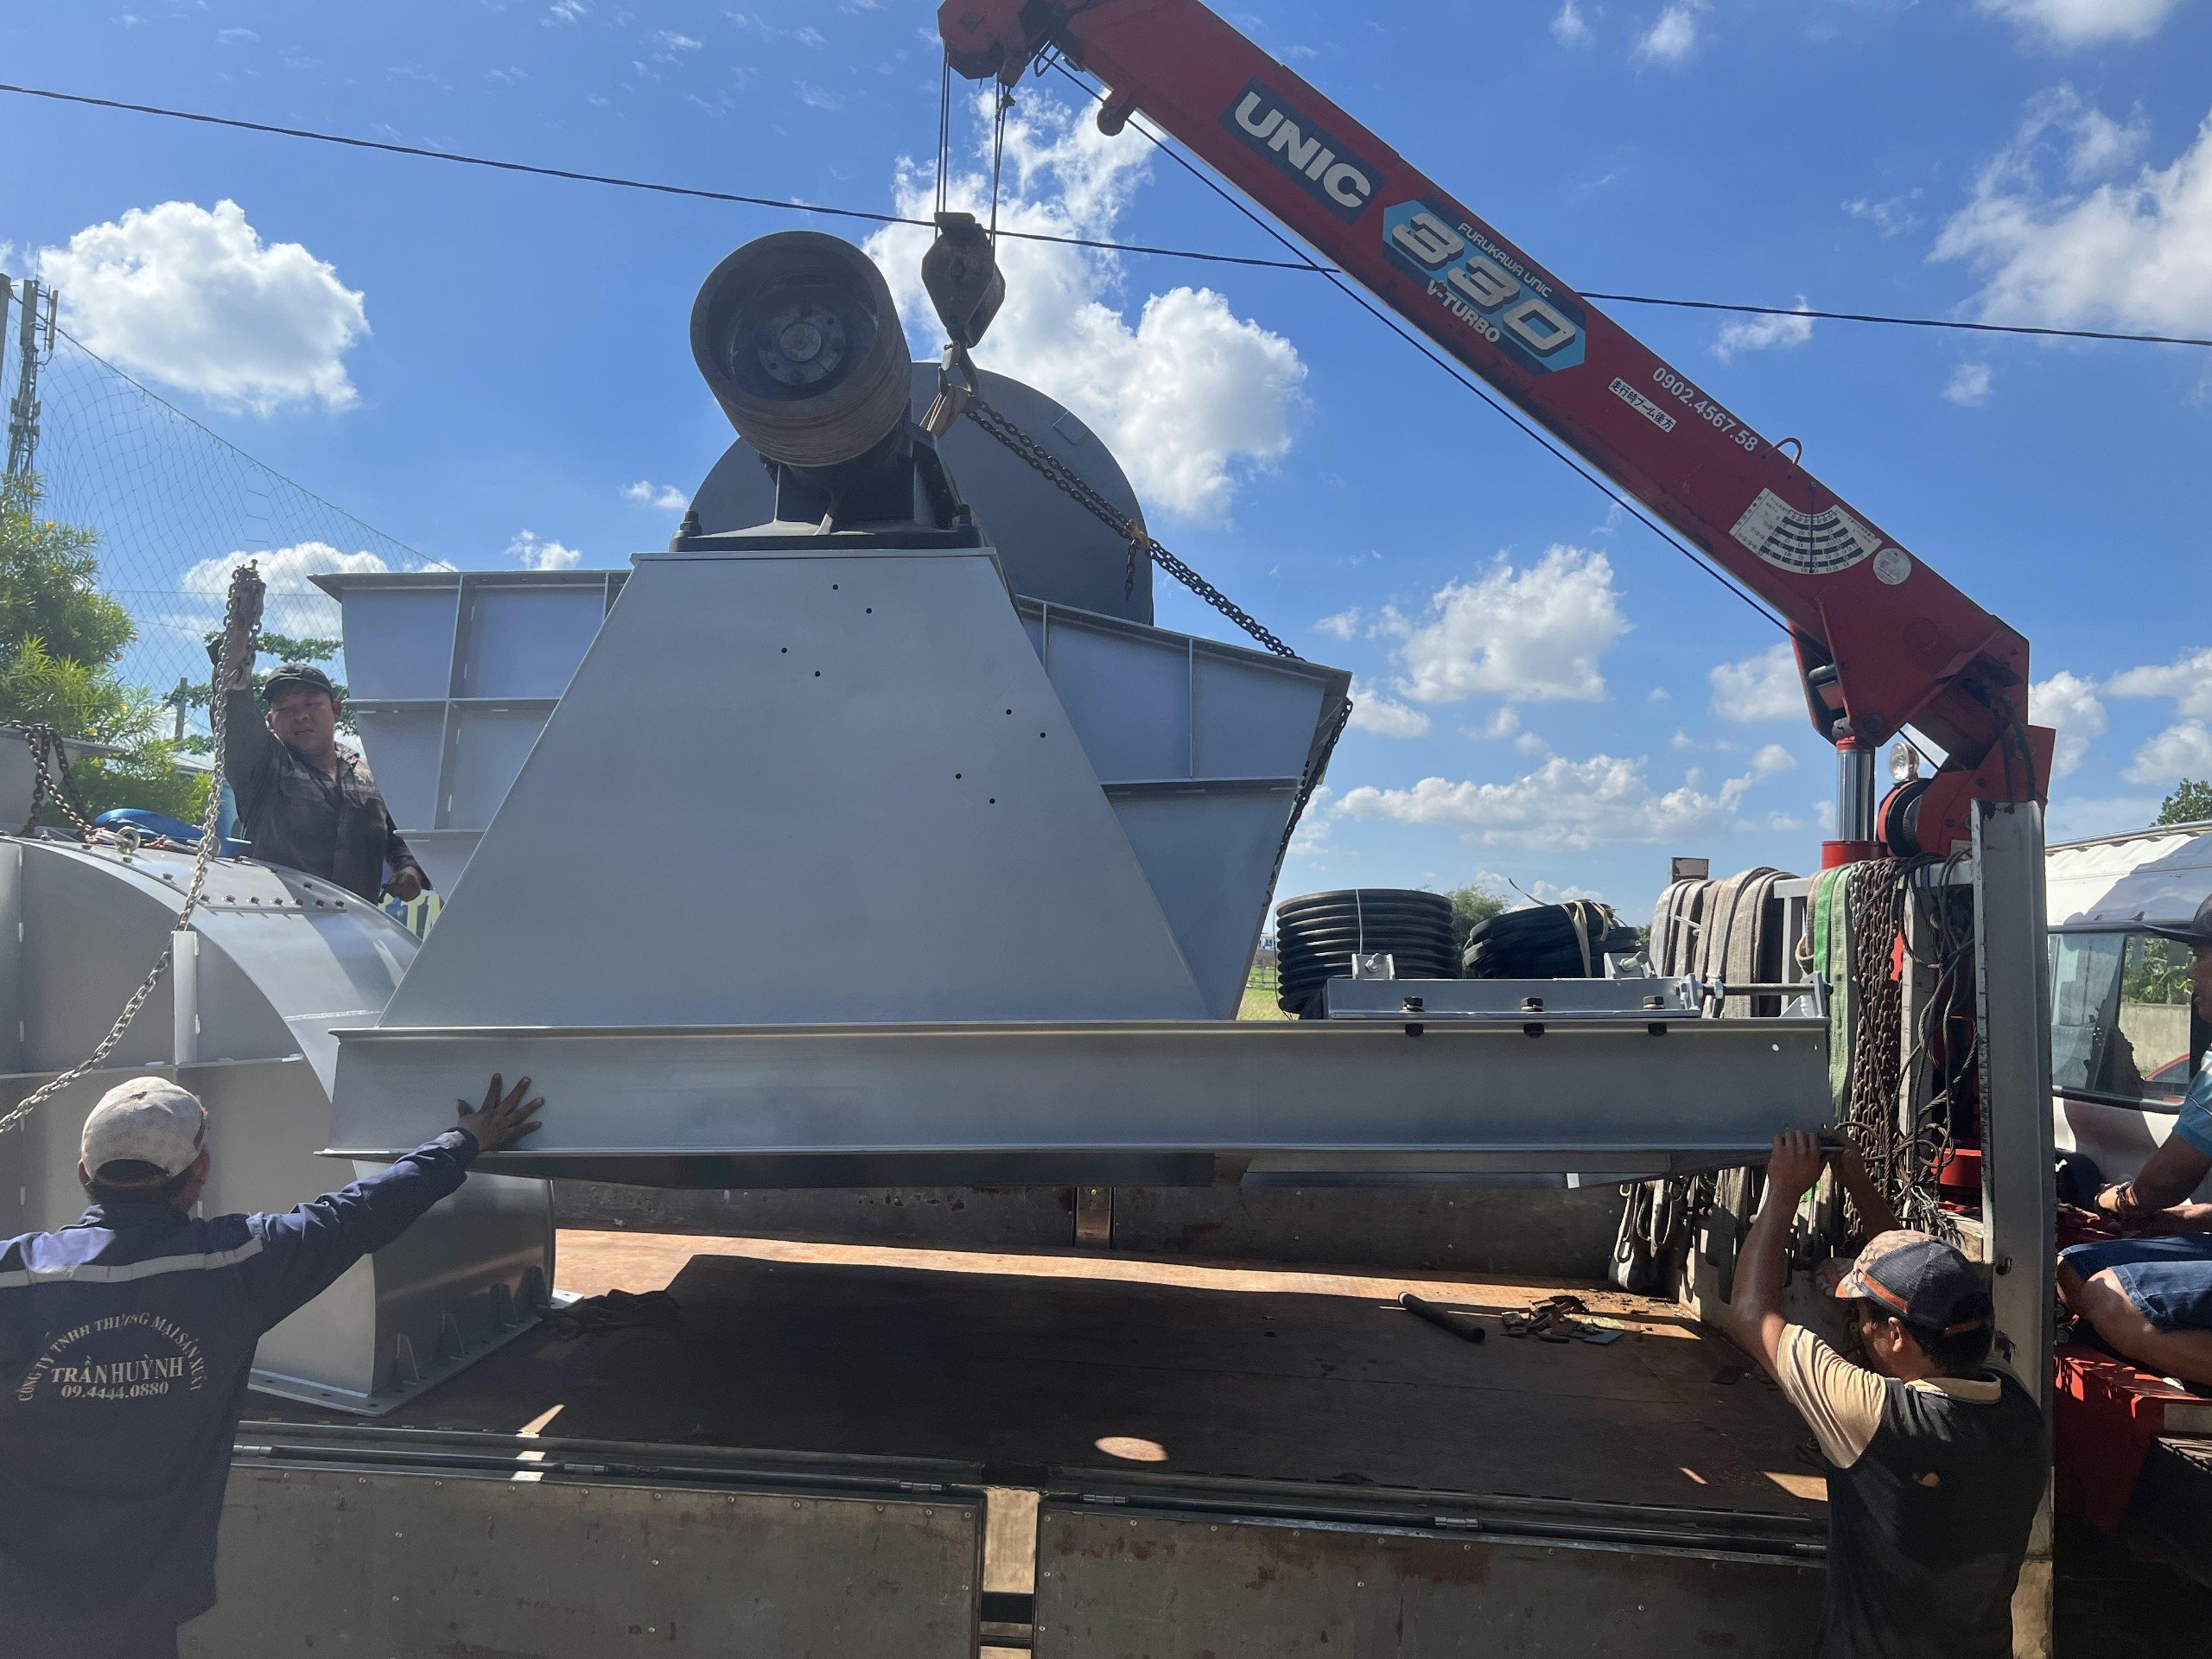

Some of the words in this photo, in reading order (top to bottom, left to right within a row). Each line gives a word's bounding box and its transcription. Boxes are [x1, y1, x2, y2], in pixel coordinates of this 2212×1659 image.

[1235, 91, 1371, 208] UNIC
[1391, 213, 1576, 353] 330
[1458, 222, 1524, 276] FURUKAWA
[1523, 271, 1554, 298] UNIC
[1427, 278, 1501, 344] V-TURBO
[1611, 379, 1675, 430] 走行時ブーム後方
[1652, 367, 1758, 452] 0902.4567.58
[50, 1325, 90, 1353] TNHH
[60, 1381, 169, 1401] 09.4444.0880
